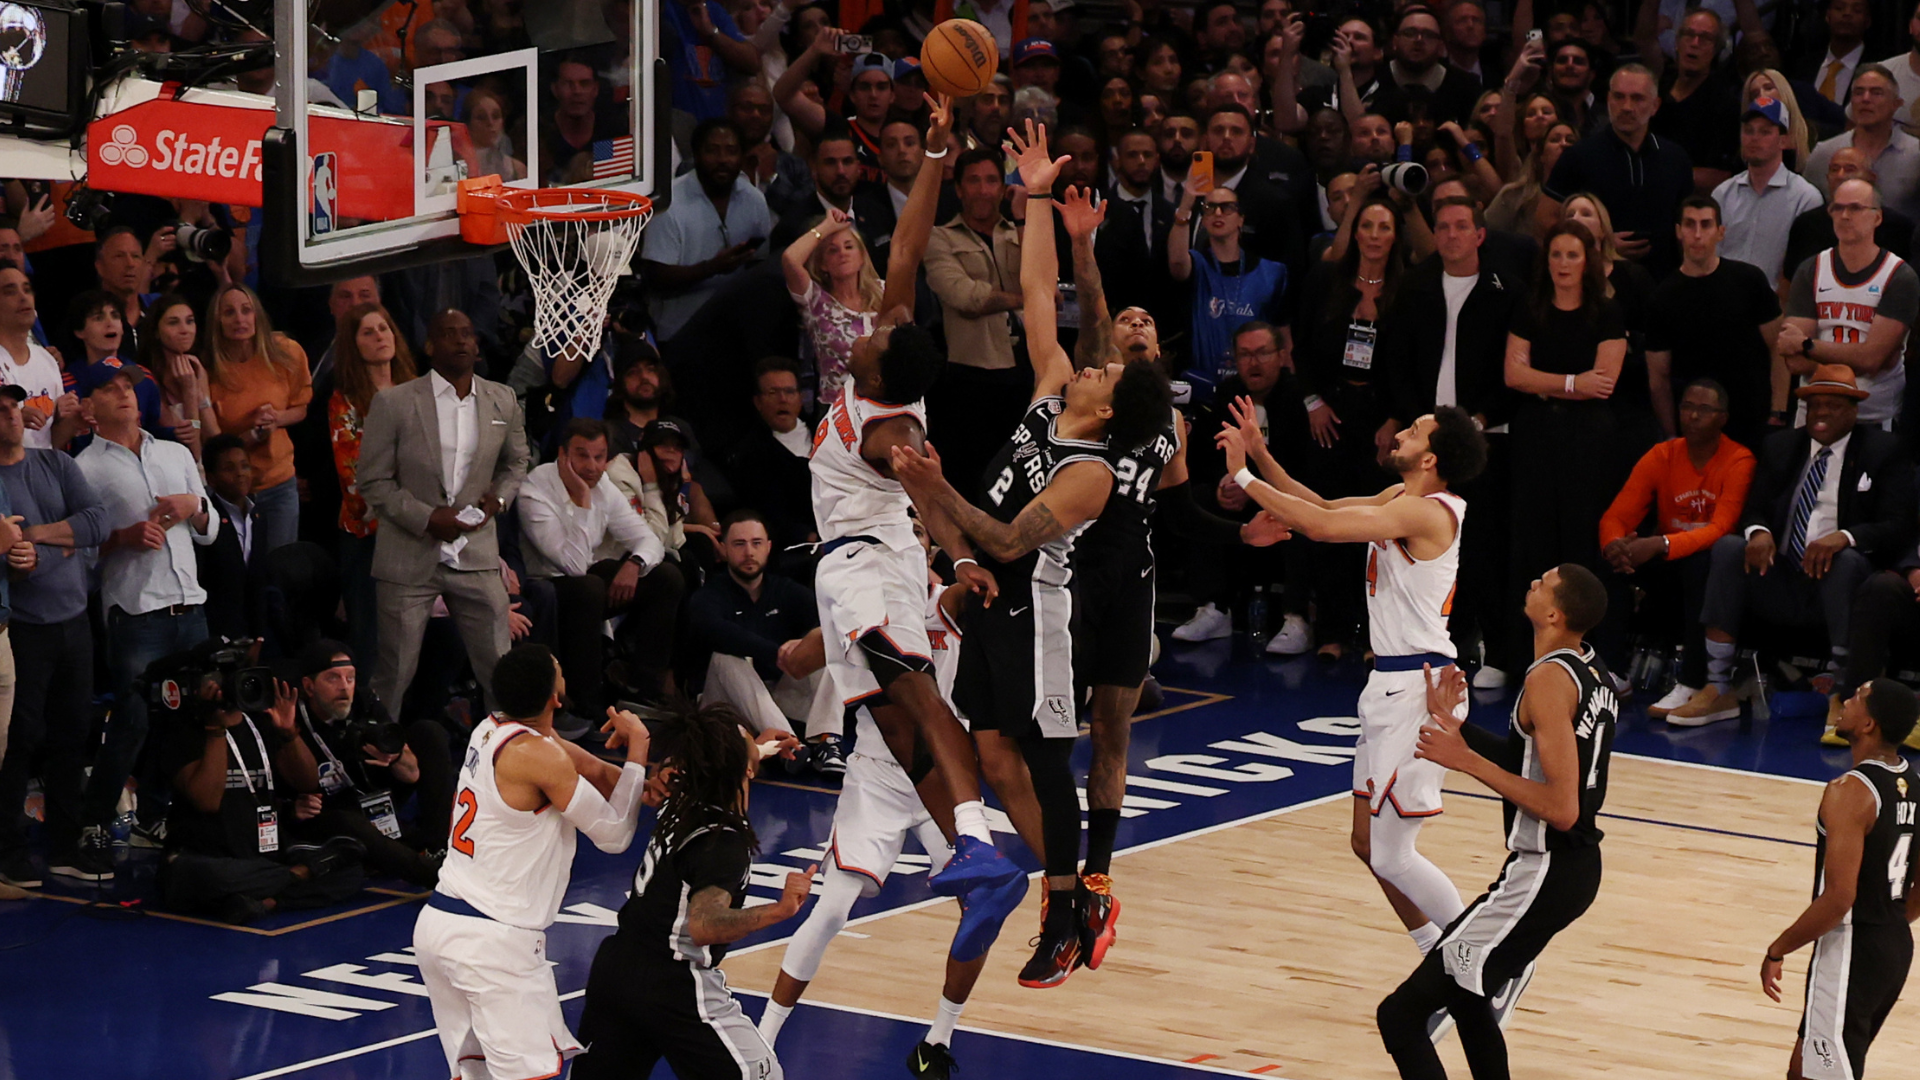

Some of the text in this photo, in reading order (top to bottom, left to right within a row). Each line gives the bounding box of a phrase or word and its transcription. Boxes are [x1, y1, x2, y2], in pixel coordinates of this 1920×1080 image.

[152, 129, 263, 182] StateF
[988, 466, 1014, 506] 2
[1117, 457, 1155, 503] 24
[1586, 722, 1606, 789] 1
[449, 787, 478, 859] 2
[1888, 833, 1914, 900] 4
